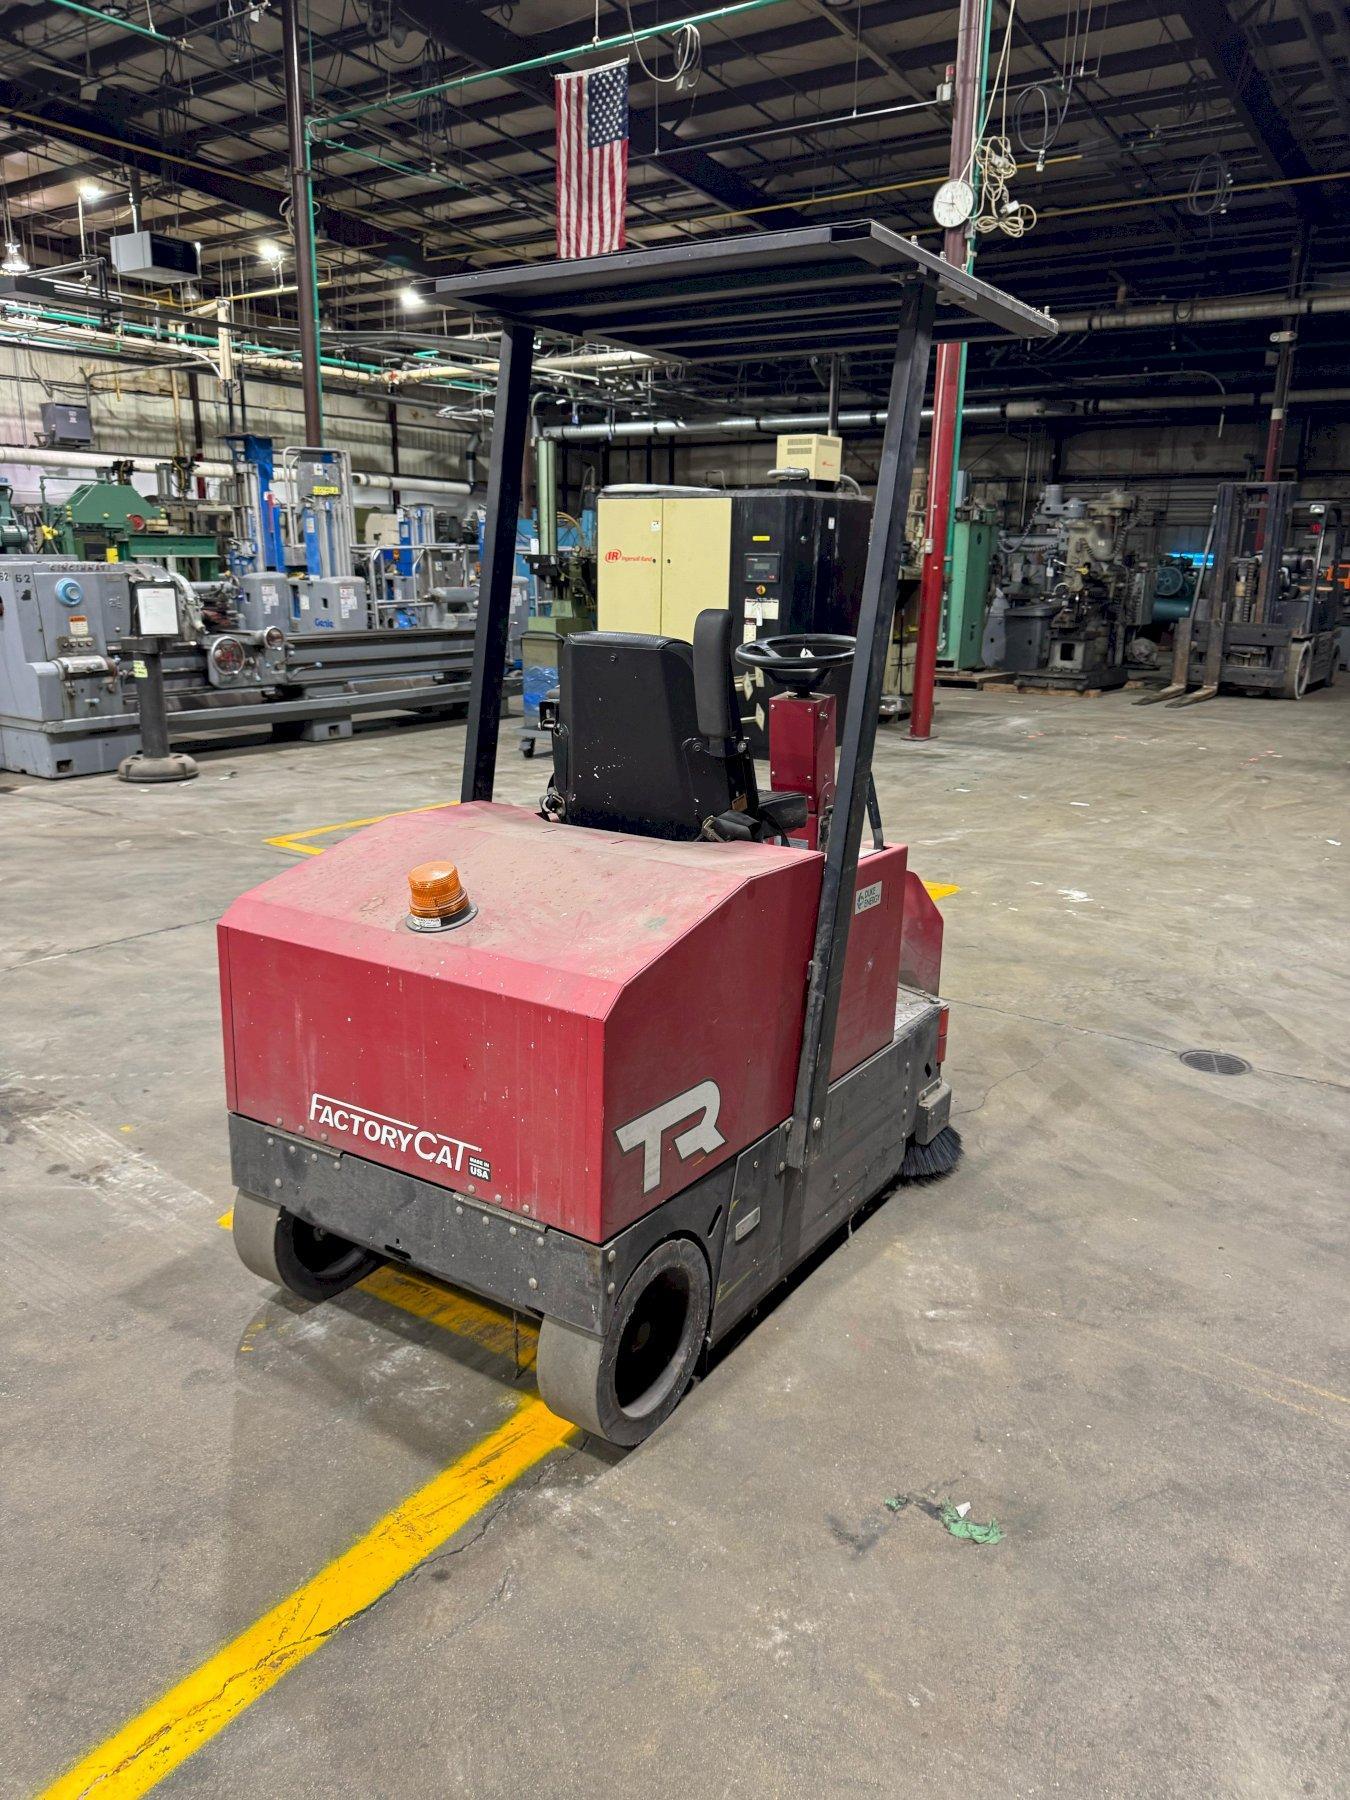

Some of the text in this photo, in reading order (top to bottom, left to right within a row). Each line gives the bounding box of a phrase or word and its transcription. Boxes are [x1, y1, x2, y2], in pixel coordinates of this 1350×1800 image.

[314, 618, 334, 628] Genie
[469, 1157, 483, 1166] MADE
[470, 1165, 489, 1180] USA
